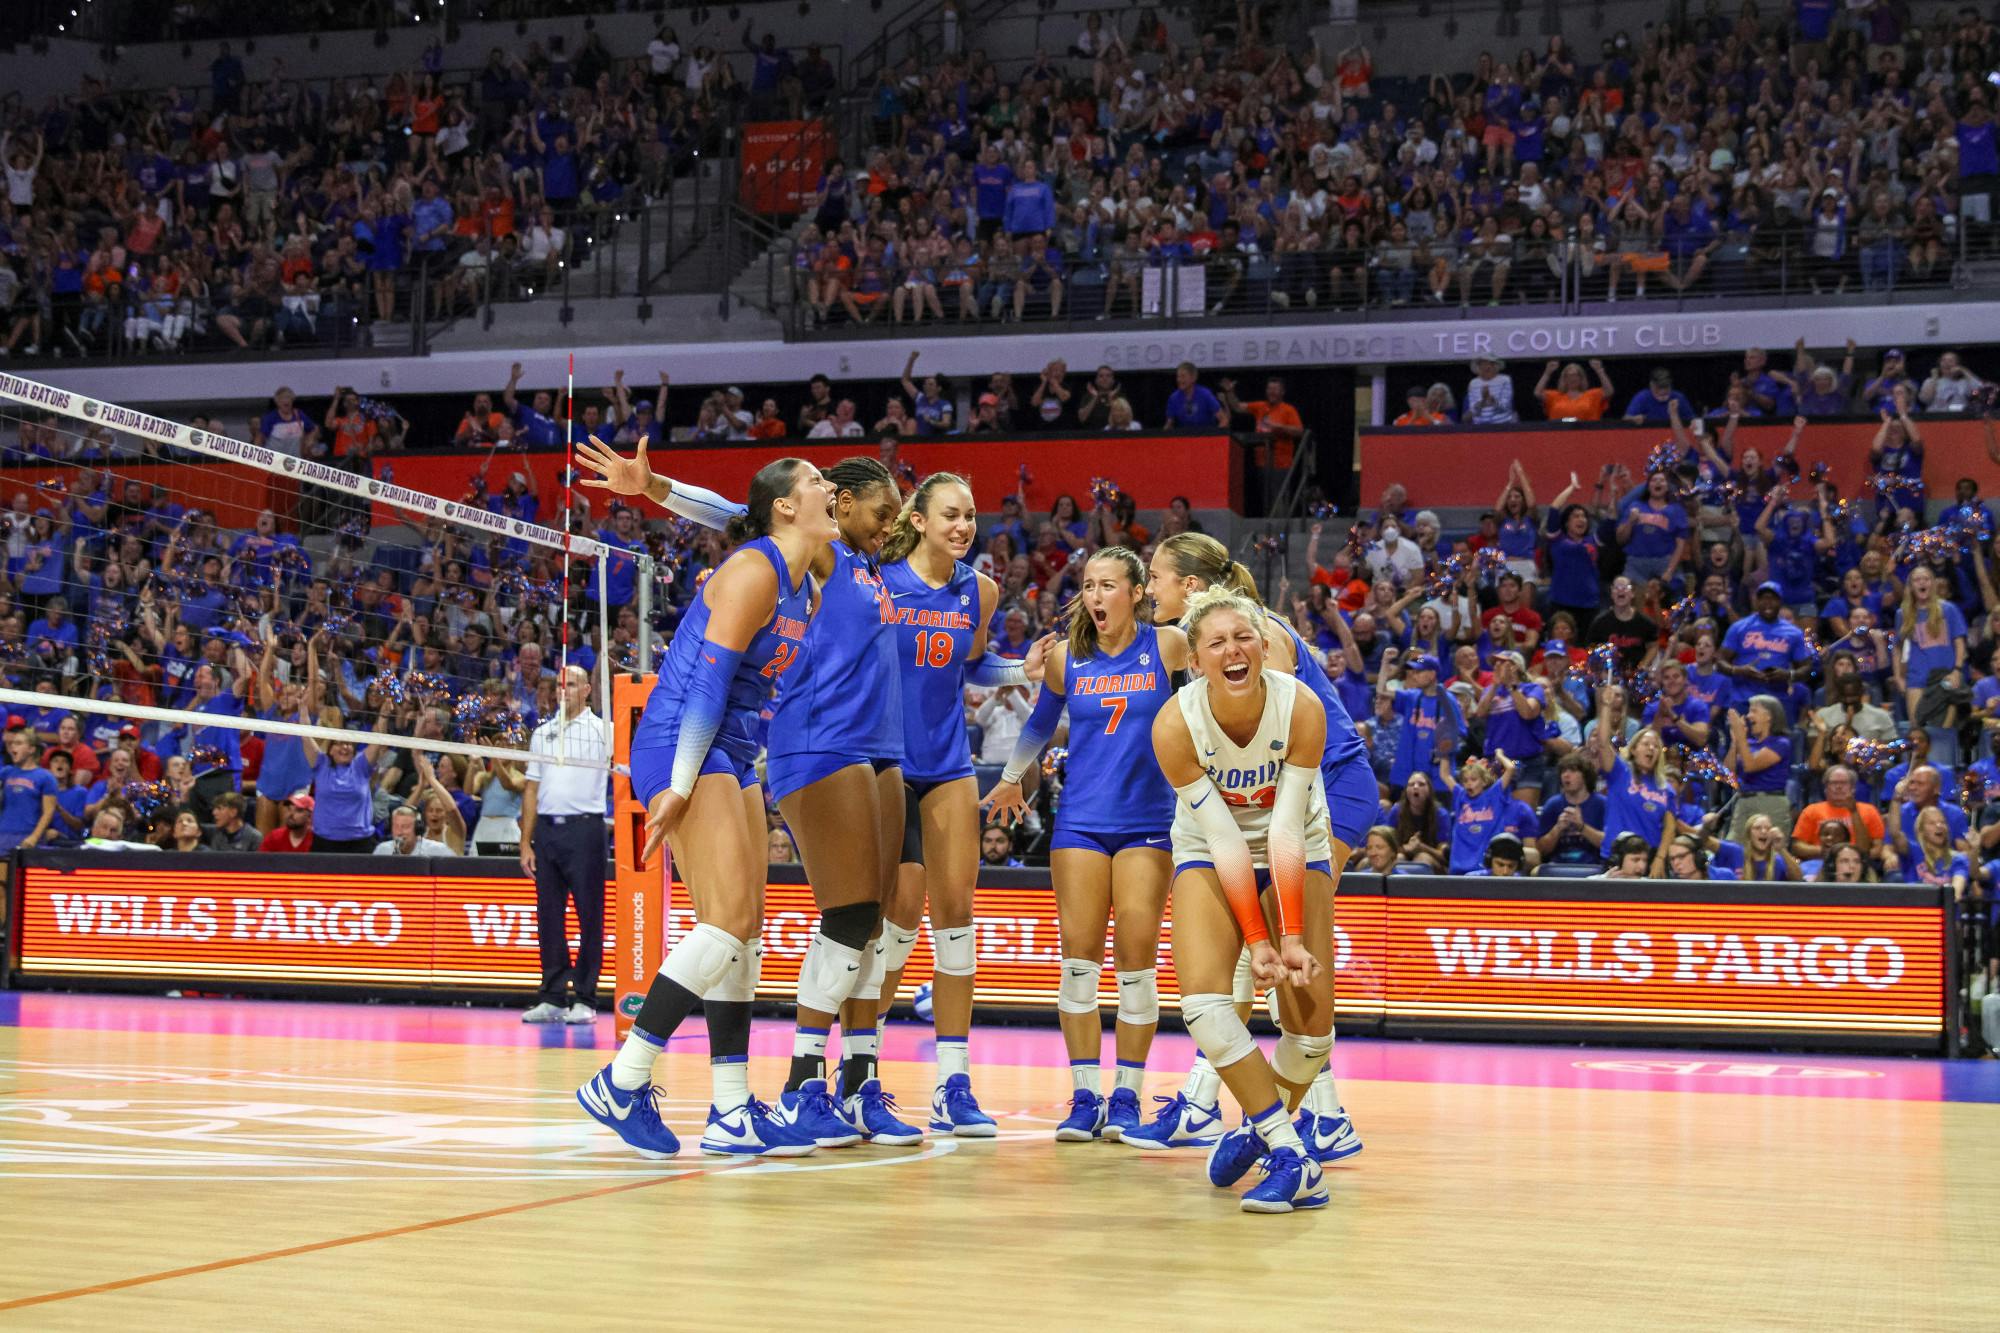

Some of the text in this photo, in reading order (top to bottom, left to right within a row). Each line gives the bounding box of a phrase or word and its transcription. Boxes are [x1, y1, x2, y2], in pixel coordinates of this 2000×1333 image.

[1103, 341, 1228, 366] GEORGE
[1243, 336, 1352, 361] BRAND
[1507, 326, 1618, 351] COURT
[1635, 324, 1721, 348] CLUB
[30, 384, 71, 409] GATORS
[100, 404, 179, 440] FLORIDA GATORS
[204, 434, 274, 466] FLORIDA GATORS
[297, 460, 361, 490] FLORIDA GATORS
[380, 485, 438, 511] FLORIDA GATORS
[457, 507, 507, 531] FLORIDA GATORS
[896, 607, 971, 629] FLORIDA
[915, 630, 954, 668] 18
[1073, 672, 1156, 695] FLORIDA
[1101, 696, 1127, 735] 7
[50, 893, 402, 947] WELLS FARGO
[632, 891, 644, 981] sports imports
[1426, 928, 1905, 989] WELLS FARGO
